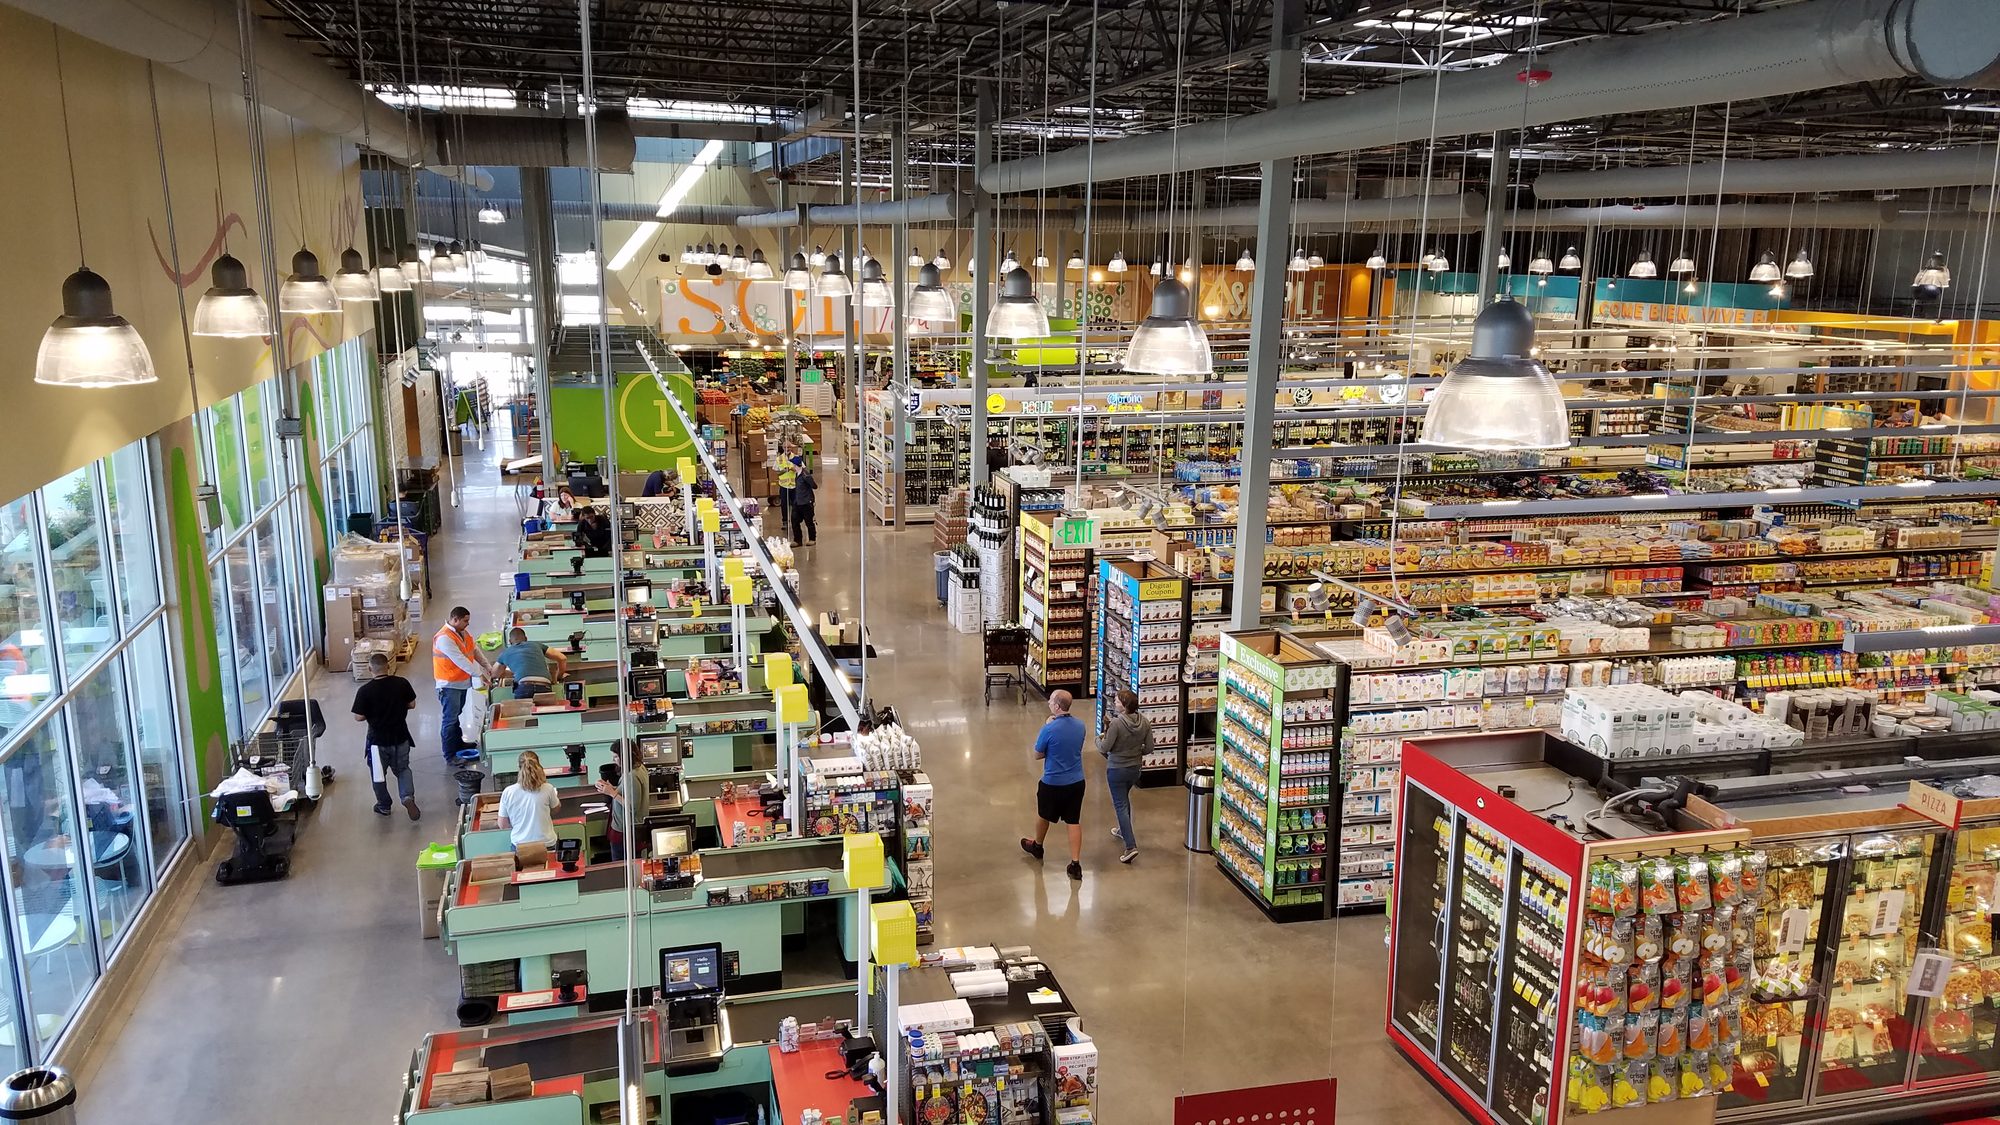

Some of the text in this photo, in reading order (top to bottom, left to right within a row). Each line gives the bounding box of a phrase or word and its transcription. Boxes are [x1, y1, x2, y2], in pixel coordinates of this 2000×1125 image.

[1600, 300, 1645, 320] COME
[1702, 307, 1745, 324] VIVE
[1064, 520, 1094, 544] EXIT
[1146, 588, 1175, 596] Coupons
[1150, 582, 1171, 590] Digital
[1240, 647, 1279, 683] Exclusive
[1921, 793, 1946, 815] PIZZA
